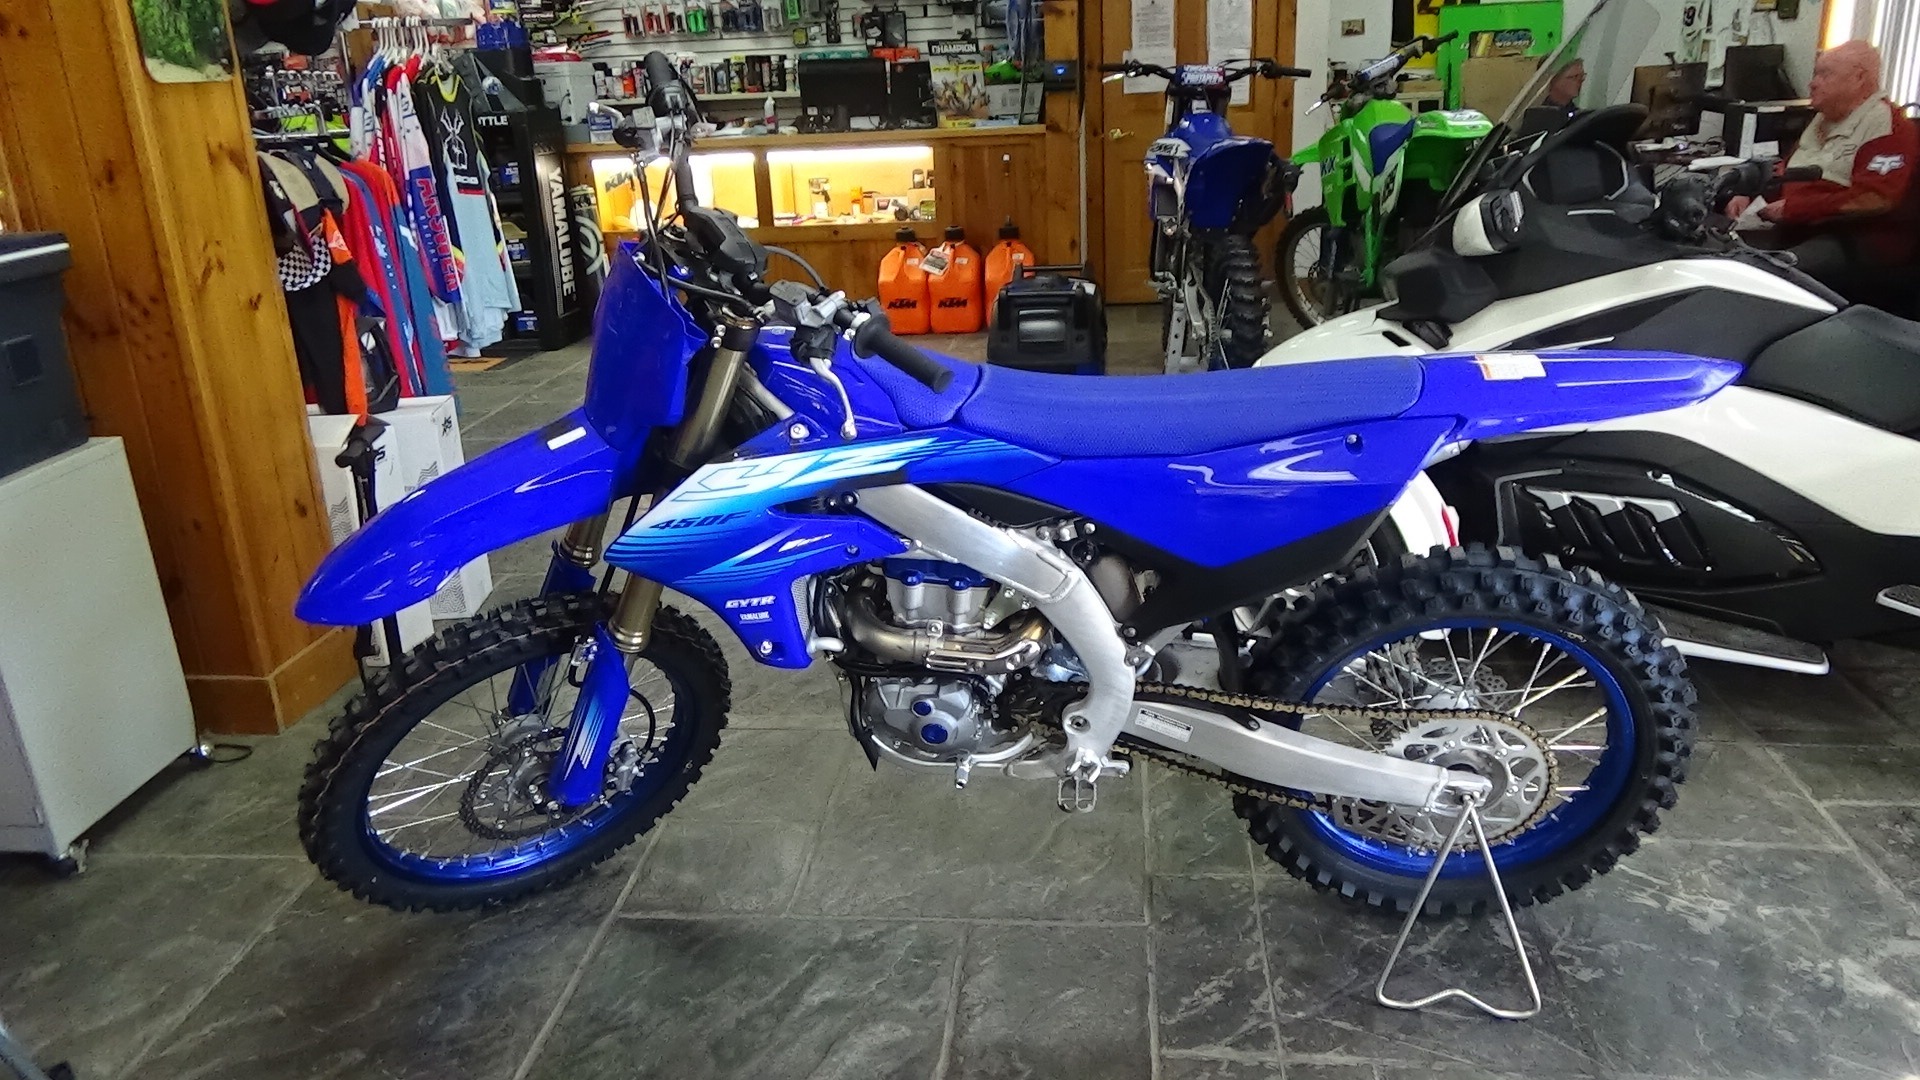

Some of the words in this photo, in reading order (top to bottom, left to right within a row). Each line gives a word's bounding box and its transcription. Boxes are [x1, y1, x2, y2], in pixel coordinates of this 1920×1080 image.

[931, 43, 976, 54] CHAMPION
[416, 178, 459, 292] ANSWER
[550, 166, 577, 297] YAMALUBE
[887, 298, 917, 309] KTM
[938, 298, 968, 308] KTM
[648, 510, 751, 530] 450F
[724, 595, 777, 609] GYTR
